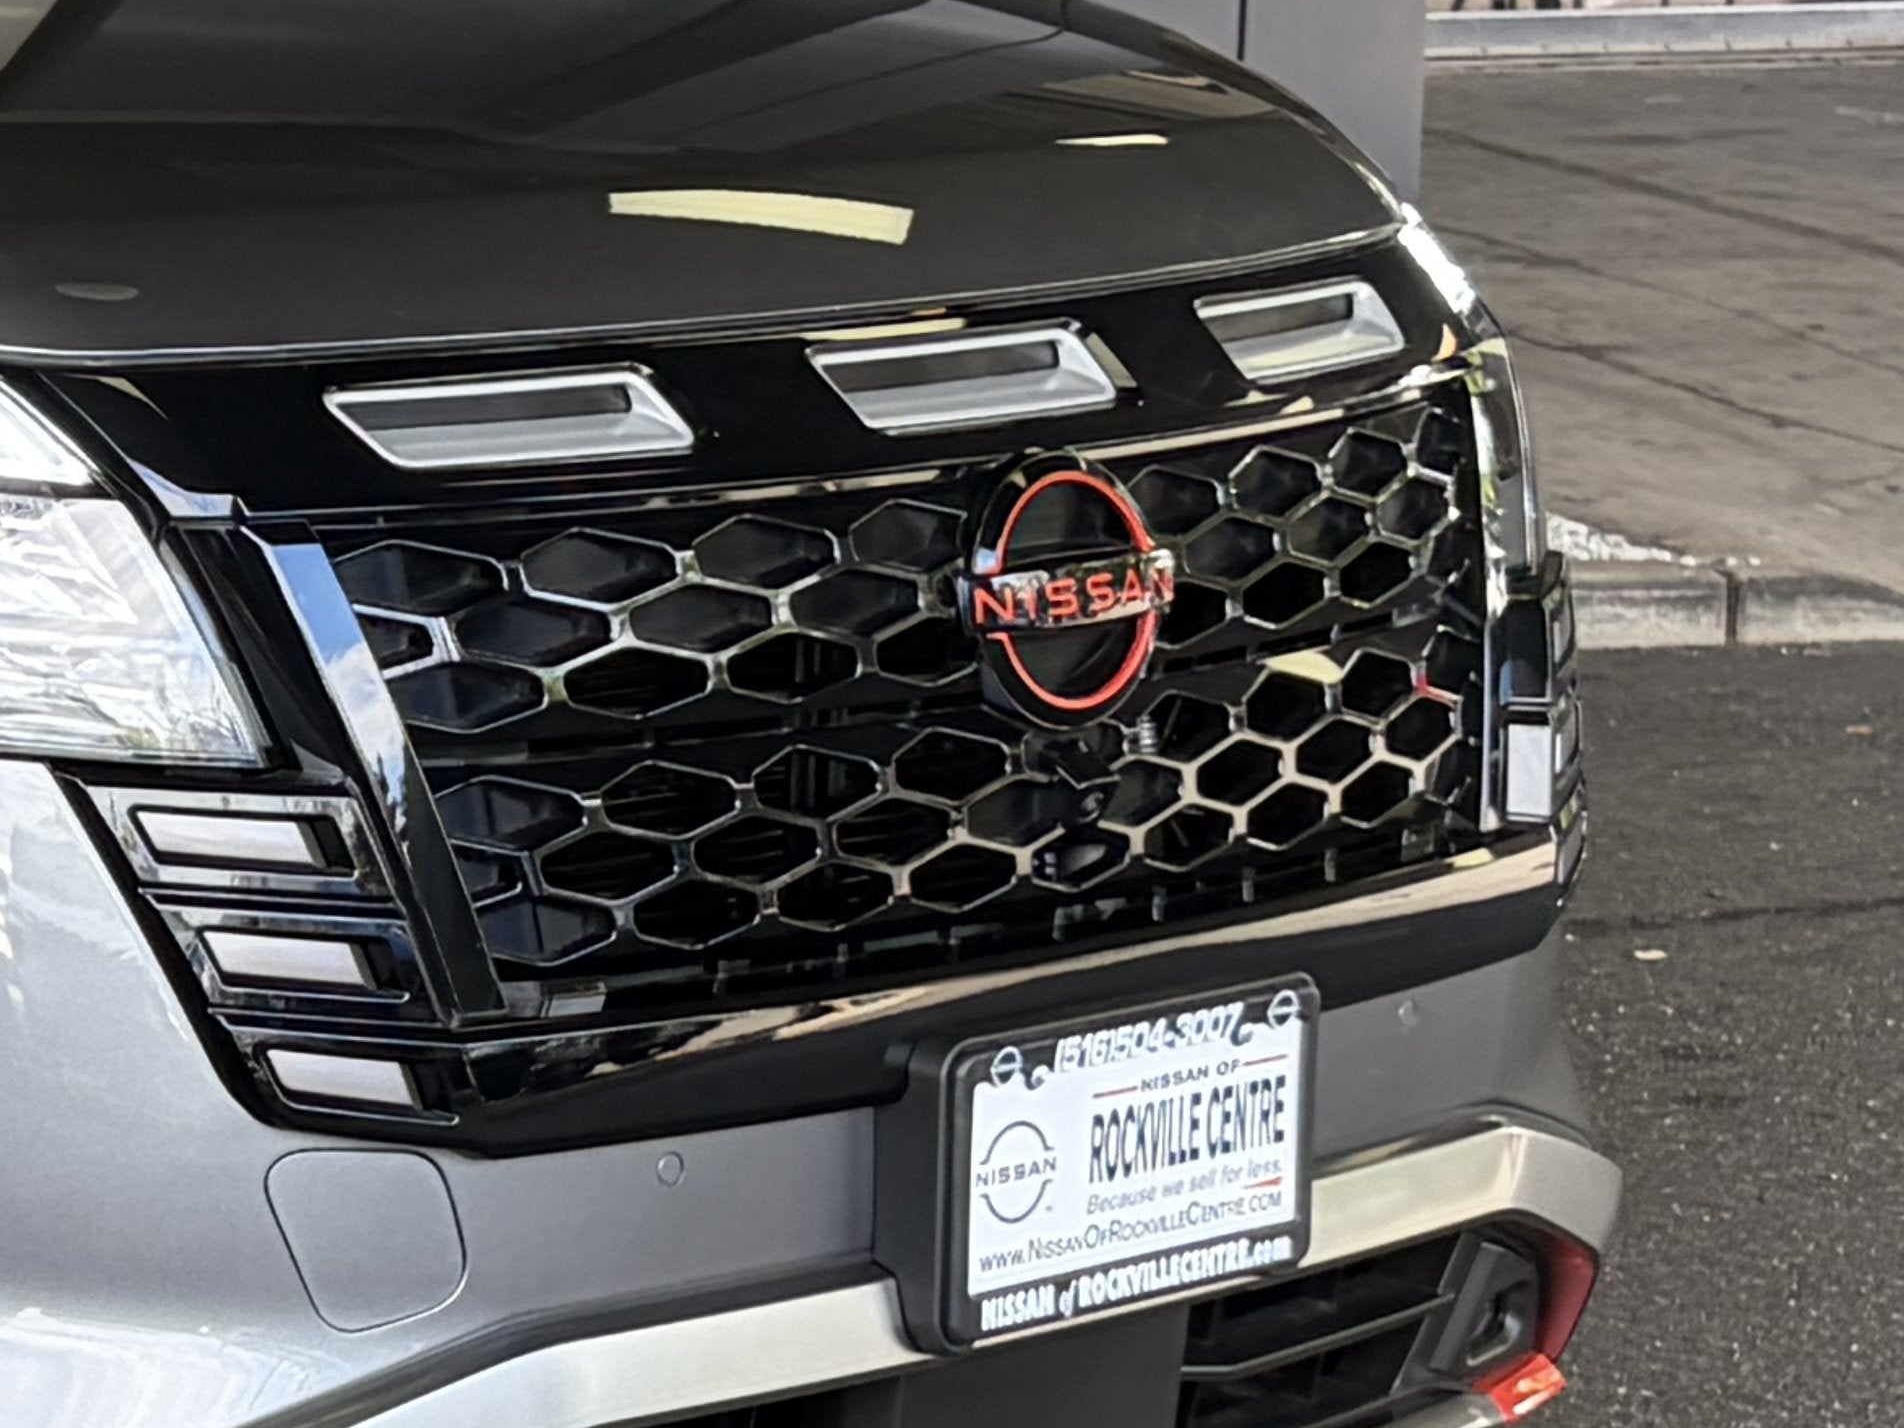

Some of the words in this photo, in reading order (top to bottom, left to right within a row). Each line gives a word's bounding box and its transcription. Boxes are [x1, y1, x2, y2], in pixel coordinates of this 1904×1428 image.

[972, 566, 1175, 625] NISSAN
[1140, 1064, 1209, 1092] NISSAN
[1216, 1058, 1241, 1077] OF
[1088, 1091, 1202, 1184] ROCKVILLE
[1206, 1074, 1287, 1159] CENTRE
[975, 1156, 1057, 1188] NISSAN
[1086, 1185, 1158, 1215] Because
[1161, 1178, 1185, 1198] we
[980, 1283, 1056, 1332] NISSAN
[1058, 1278, 1078, 1318] of
